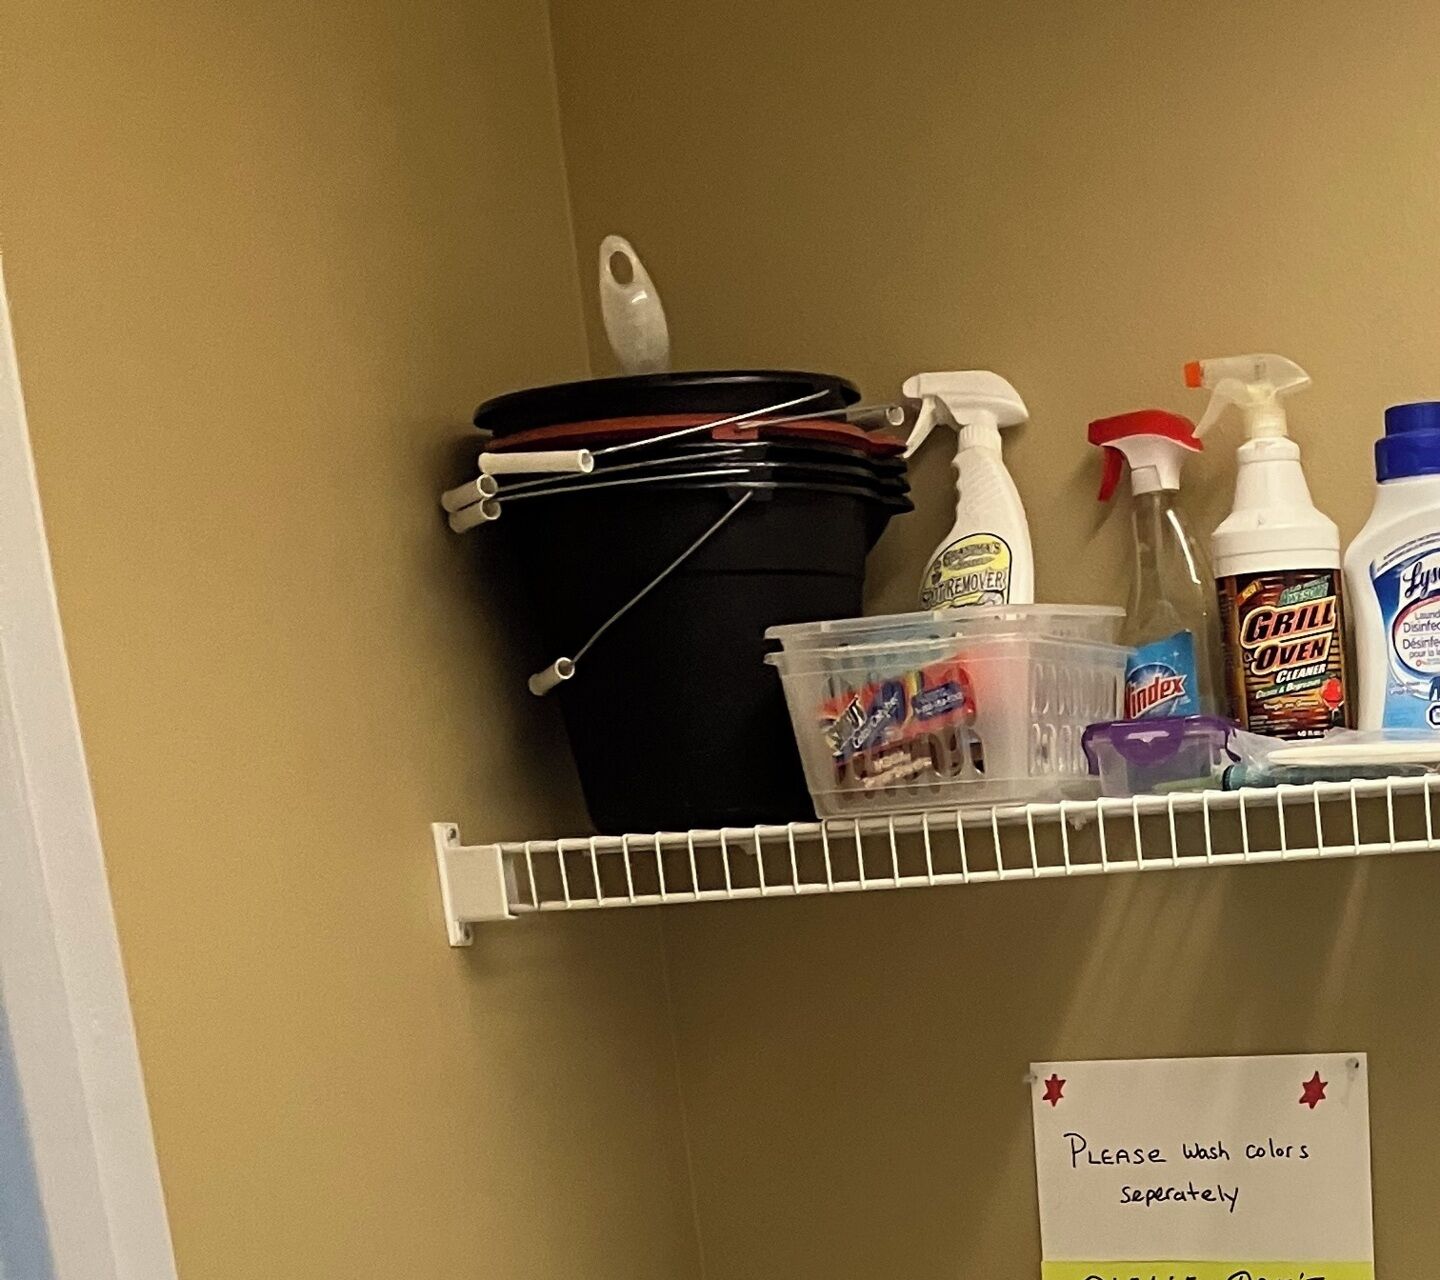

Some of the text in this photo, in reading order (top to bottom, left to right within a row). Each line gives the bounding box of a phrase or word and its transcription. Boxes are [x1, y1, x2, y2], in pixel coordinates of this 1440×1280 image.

[946, 571, 1003, 598] REMOVER
[1246, 602, 1334, 643] GRILL
[1257, 638, 1329, 670] OVEN
[1276, 664, 1327, 684] CLEANER
[1120, 1181, 1239, 1213] seperately
